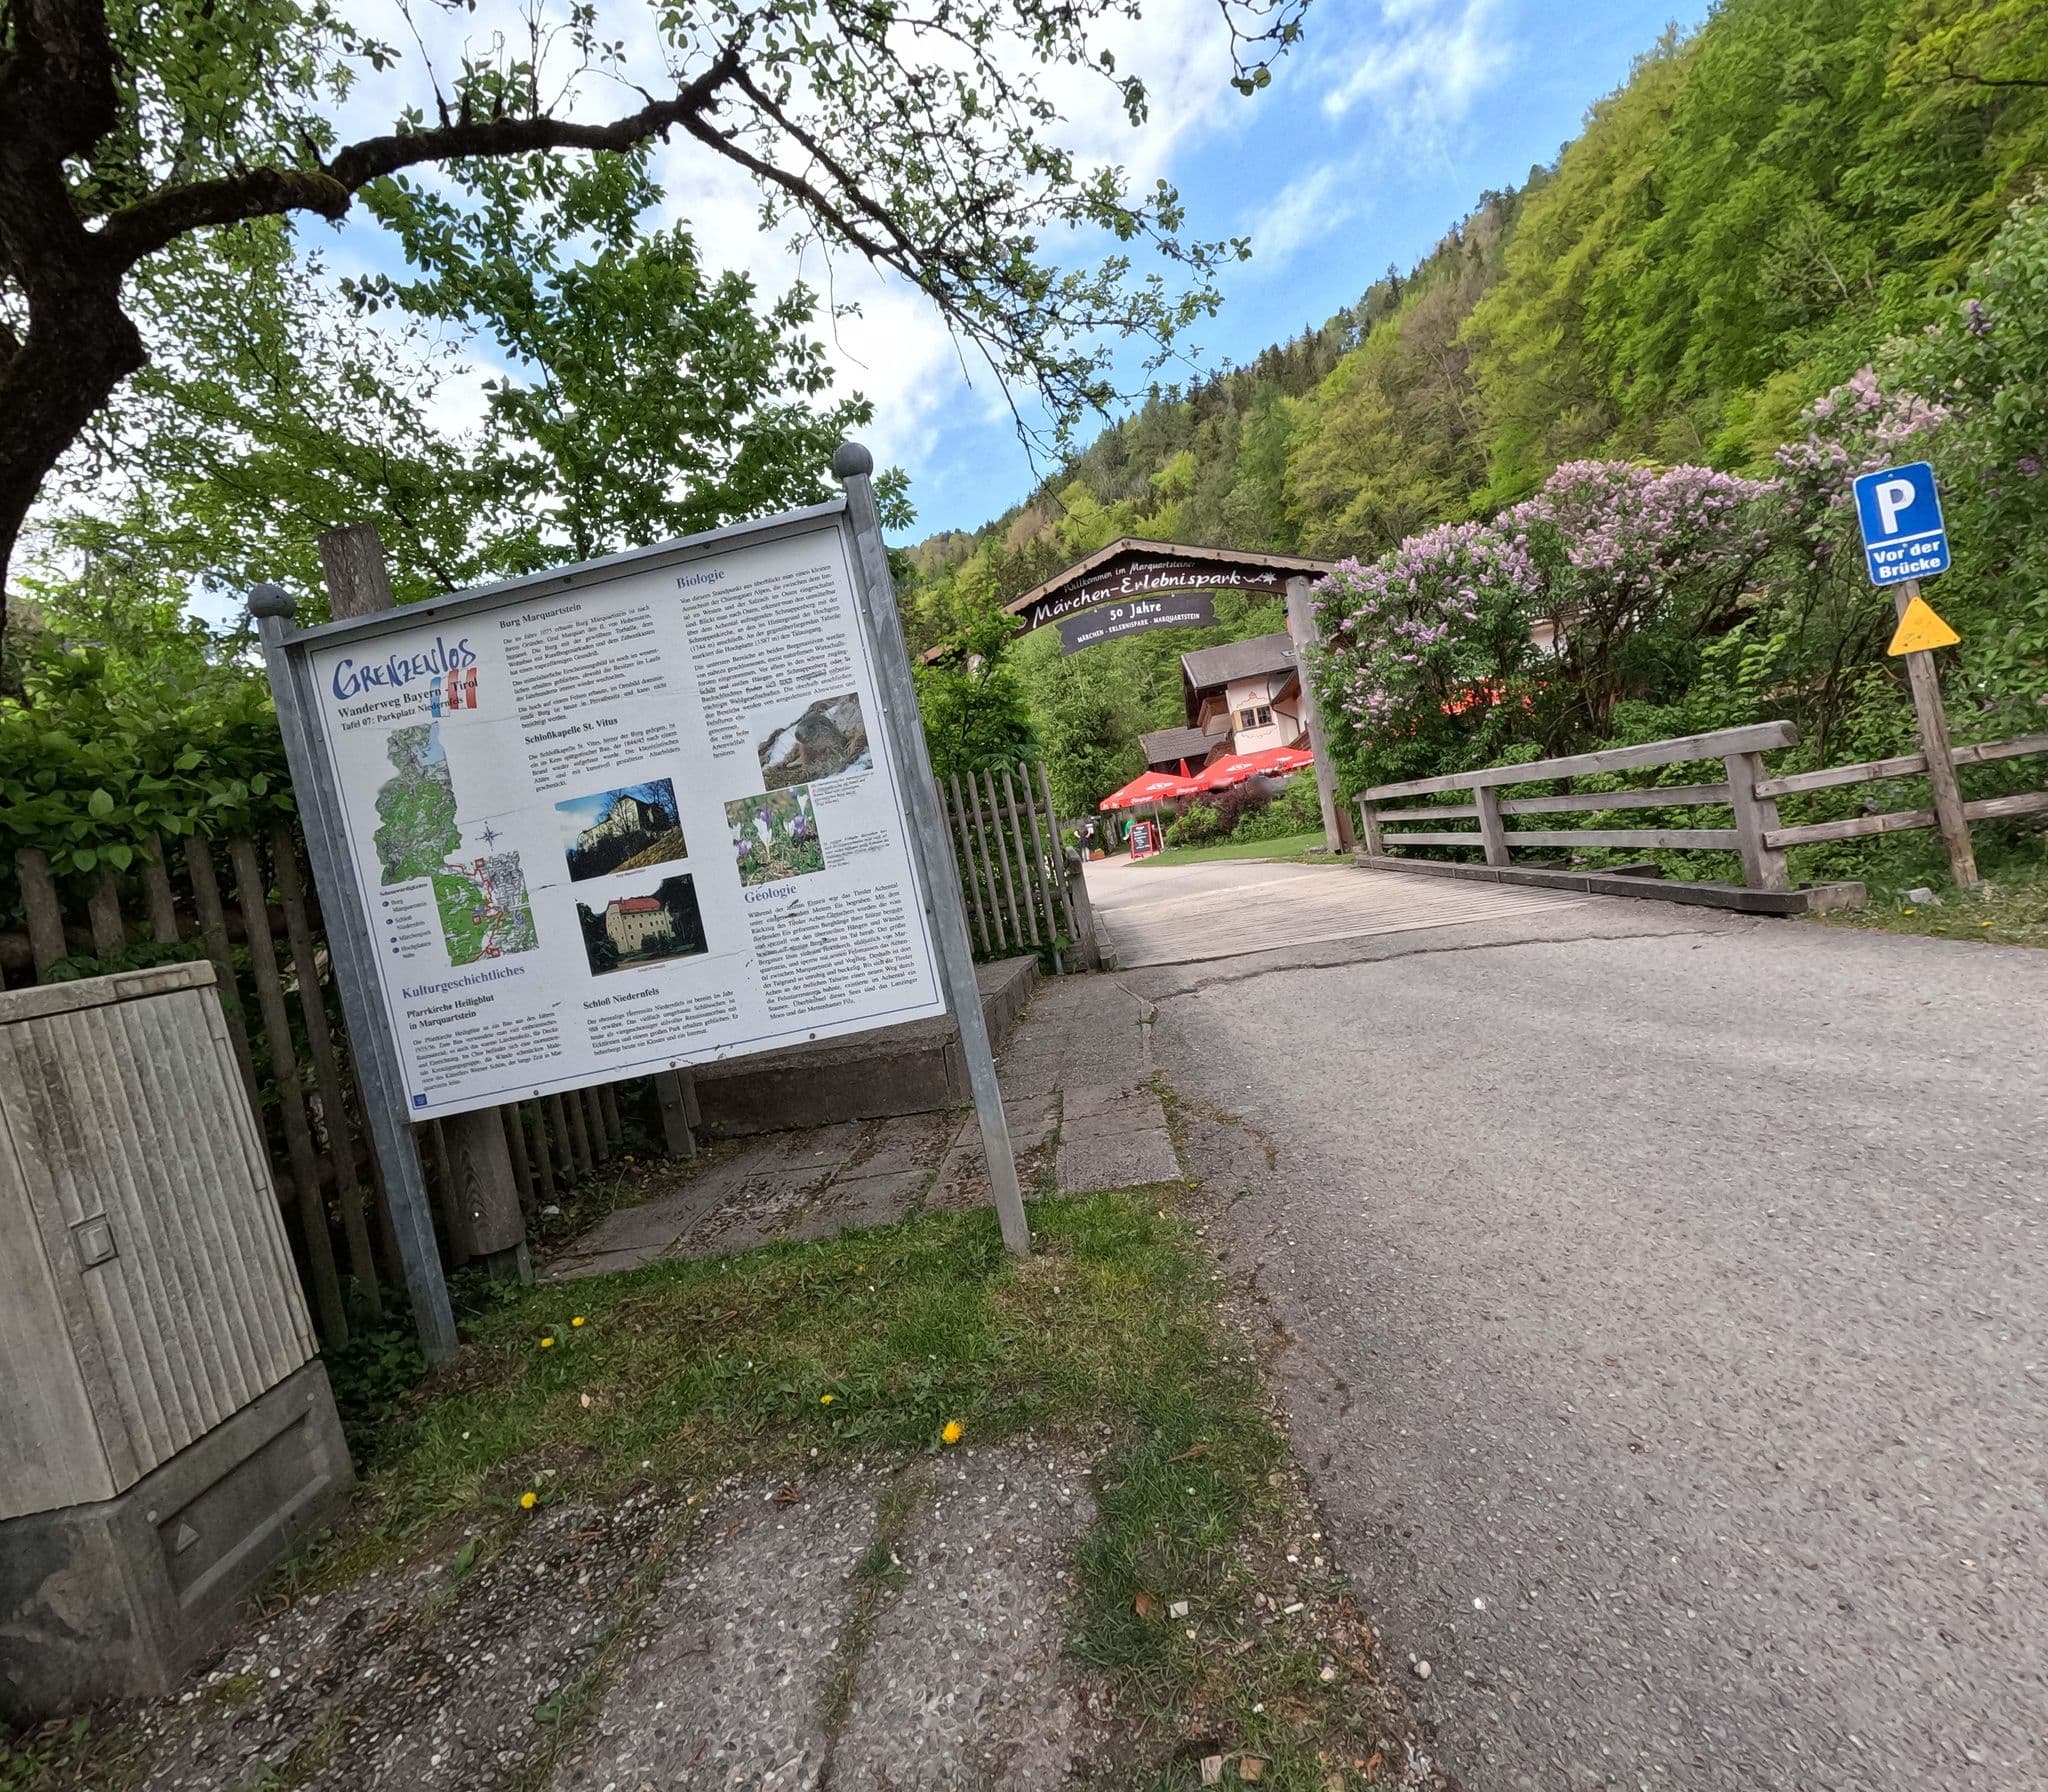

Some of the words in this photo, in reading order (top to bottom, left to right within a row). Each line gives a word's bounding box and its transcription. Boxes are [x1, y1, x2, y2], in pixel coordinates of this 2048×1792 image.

[1876, 479, 1915, 534] P
[1874, 549, 1904, 563] Vor
[1910, 541, 1940, 556] der
[676, 569, 726, 589] Biologie
[1879, 557, 1941, 578] Brücke
[499, 618, 521, 628] Burg
[521, 604, 582, 623] Marquartstein
[1110, 608, 1123, 620] 50
[1130, 602, 1162, 618] Jahre
[1077, 630, 1104, 643] MÄRCHEN
[1108, 620, 1149, 633] ERLEBNISPARK
[1154, 613, 1200, 625] MARQUARTSTEIN
[338, 697, 401, 718] Wanderweg
[403, 688, 441, 705] Bayern
[451, 678, 478, 692] Tirol
[341, 721, 361, 731] Tafel
[362, 717, 375, 726] 07:
[377, 709, 416, 724] Parkplatz
[418, 698, 463, 712] Niedernfels
[524, 726, 582, 745] Schloßkapelle
[582, 722, 595, 732] St.
[596, 718, 618, 728] Vitus
[744, 884, 798, 903] Geologie
[402, 966, 526, 999] Kulturgeschichtliches
[406, 1003, 453, 1019] Pfarrkirche
[455, 994, 495, 1009] Heiligblut
[582, 997, 612, 1010] Schloß
[612, 987, 660, 1004] Niedernfels
[418, 1010, 477, 1028] Marquartstein
